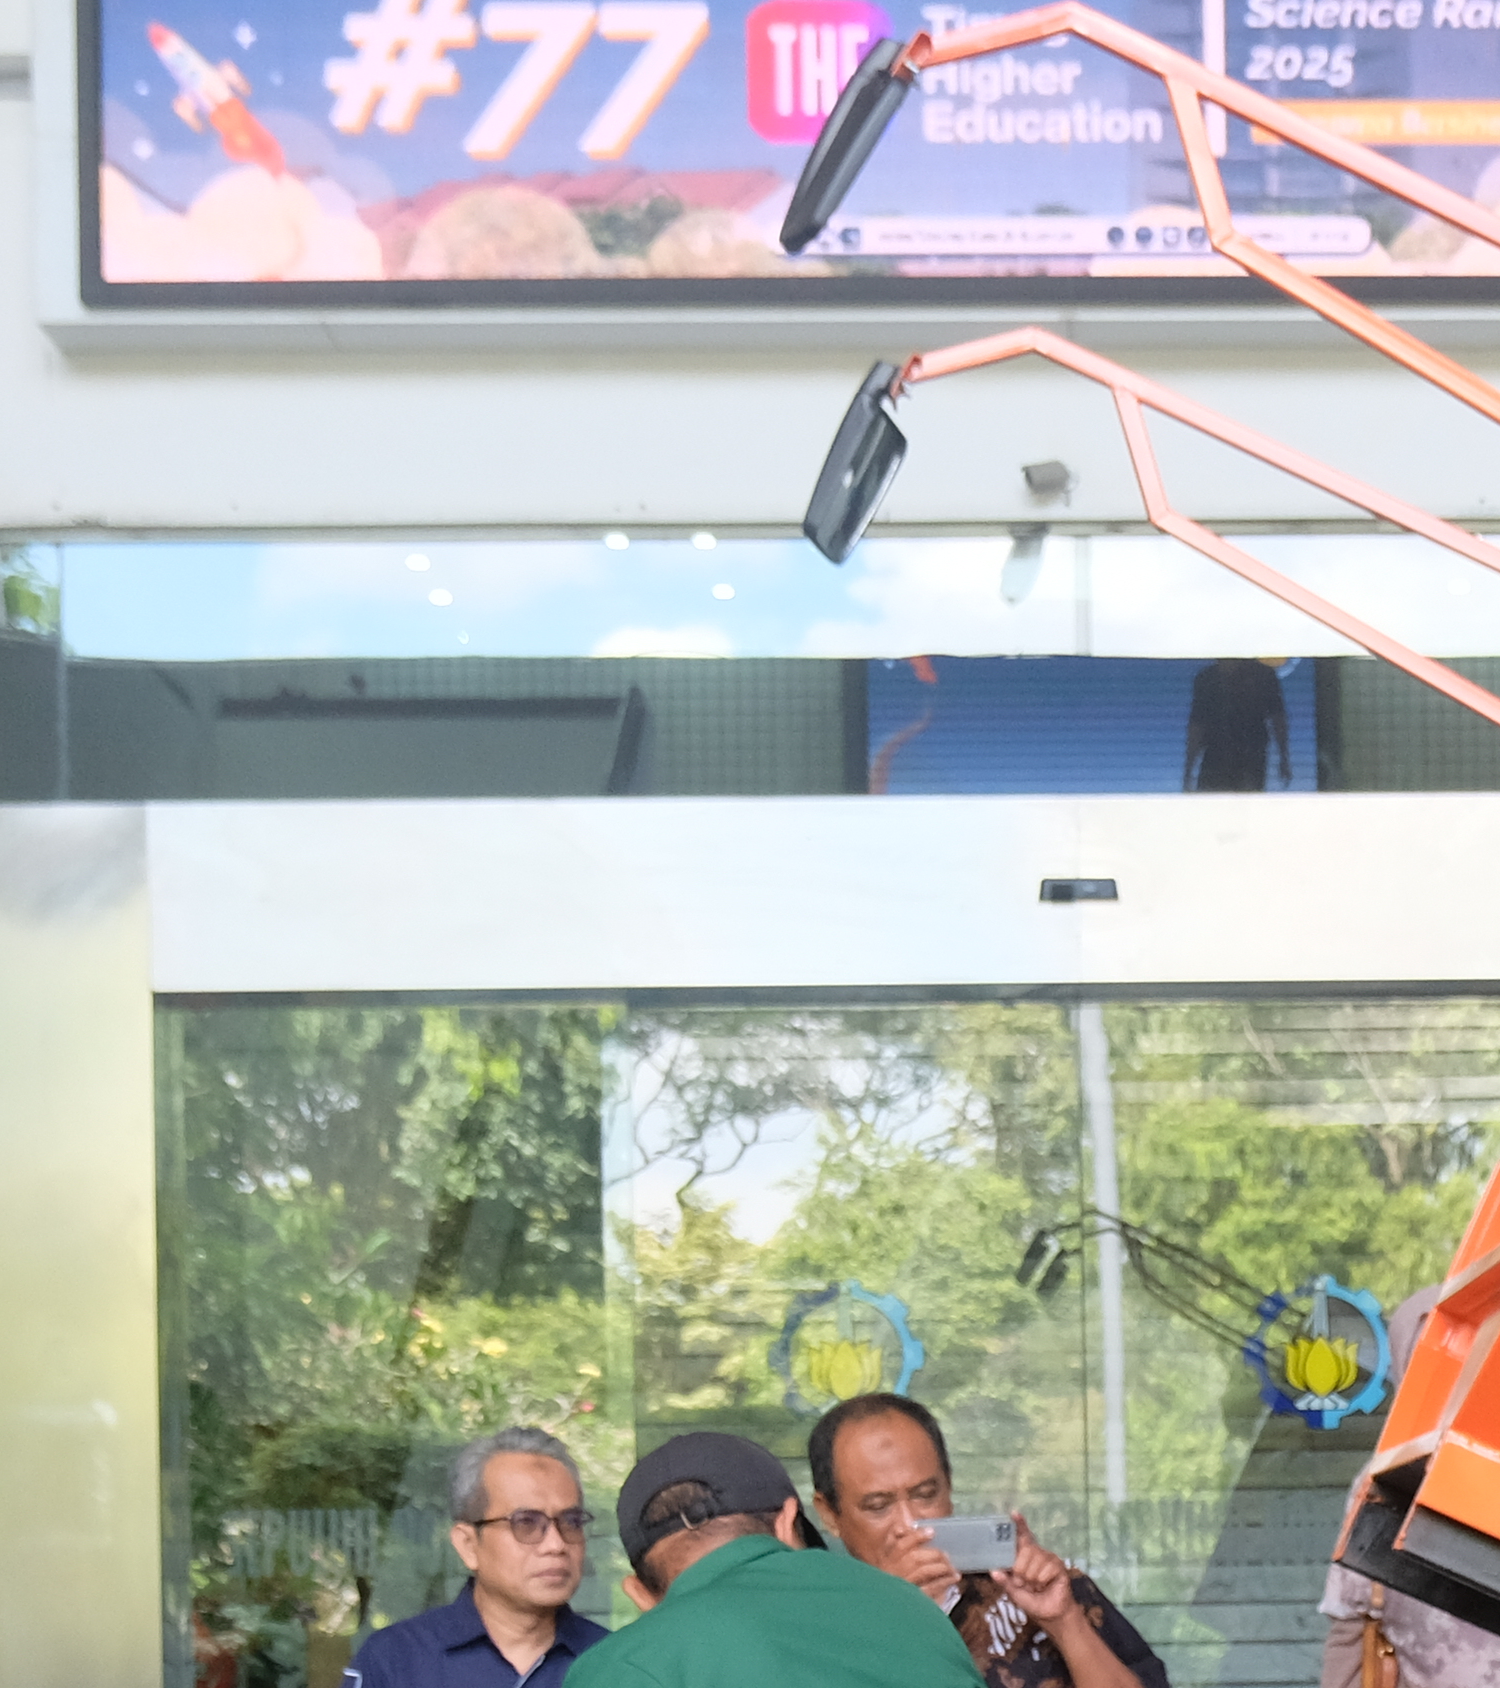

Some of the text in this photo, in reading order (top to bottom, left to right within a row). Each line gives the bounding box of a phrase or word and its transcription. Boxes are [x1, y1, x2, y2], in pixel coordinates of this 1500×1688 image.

[322, 0, 711, 160] #77
[922, 53, 1083, 102] Higher
[1244, 44, 1354, 87] 2025
[923, 108, 1164, 144] Education
